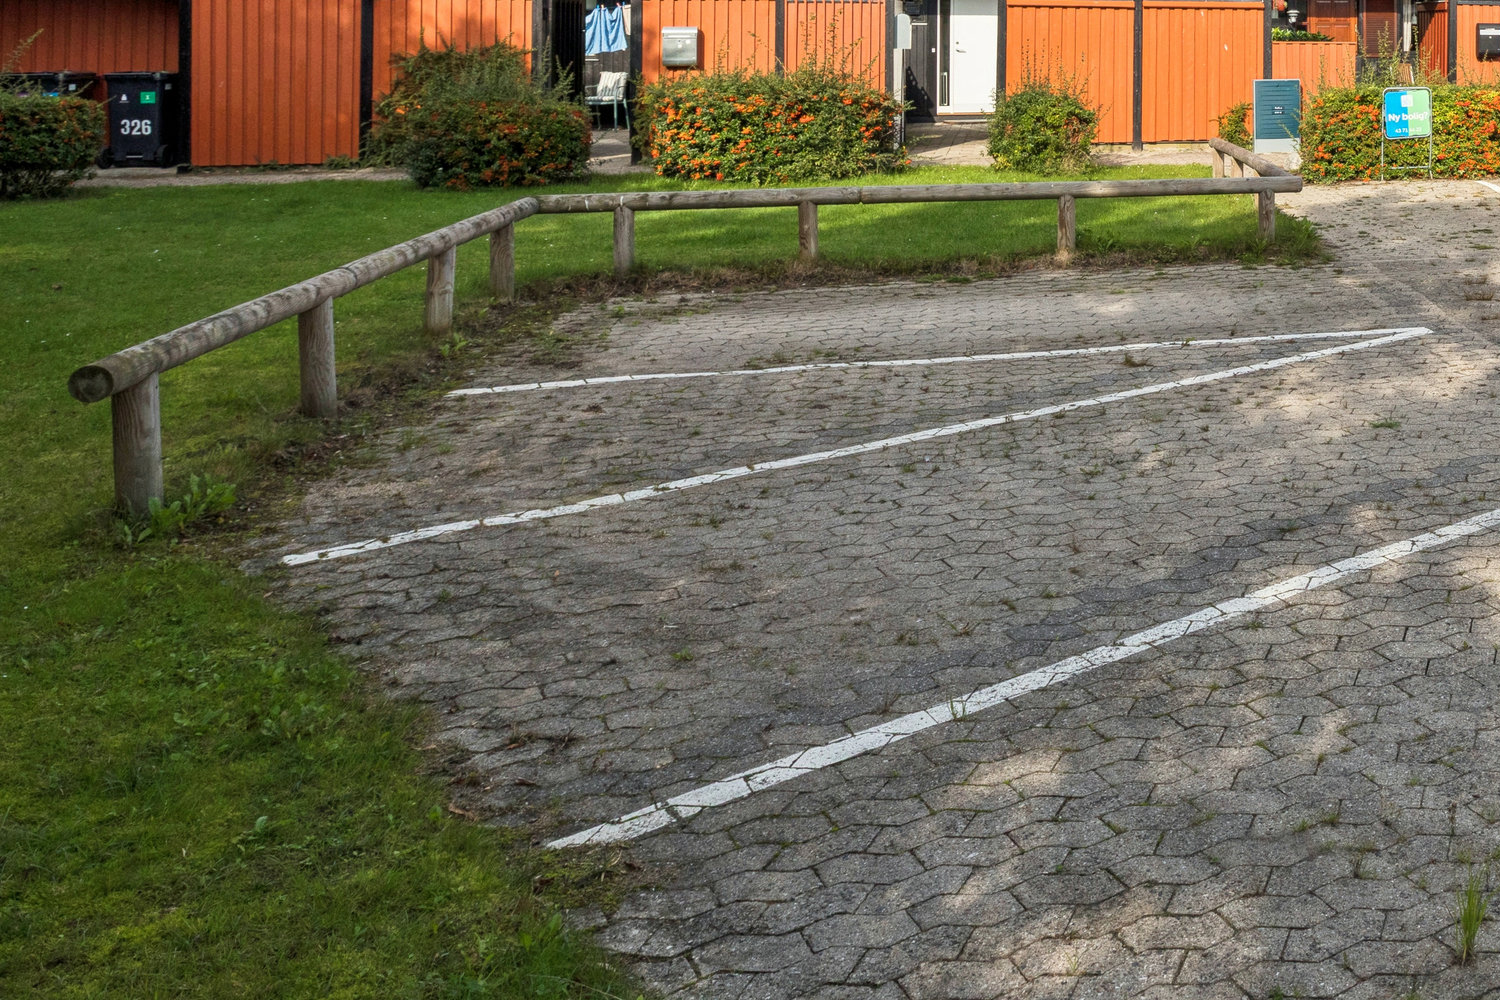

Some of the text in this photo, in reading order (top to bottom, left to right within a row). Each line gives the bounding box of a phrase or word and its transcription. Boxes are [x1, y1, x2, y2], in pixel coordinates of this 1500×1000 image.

[1387, 111, 1428, 123] Ny bolig?
[120, 119, 152, 135] 326
